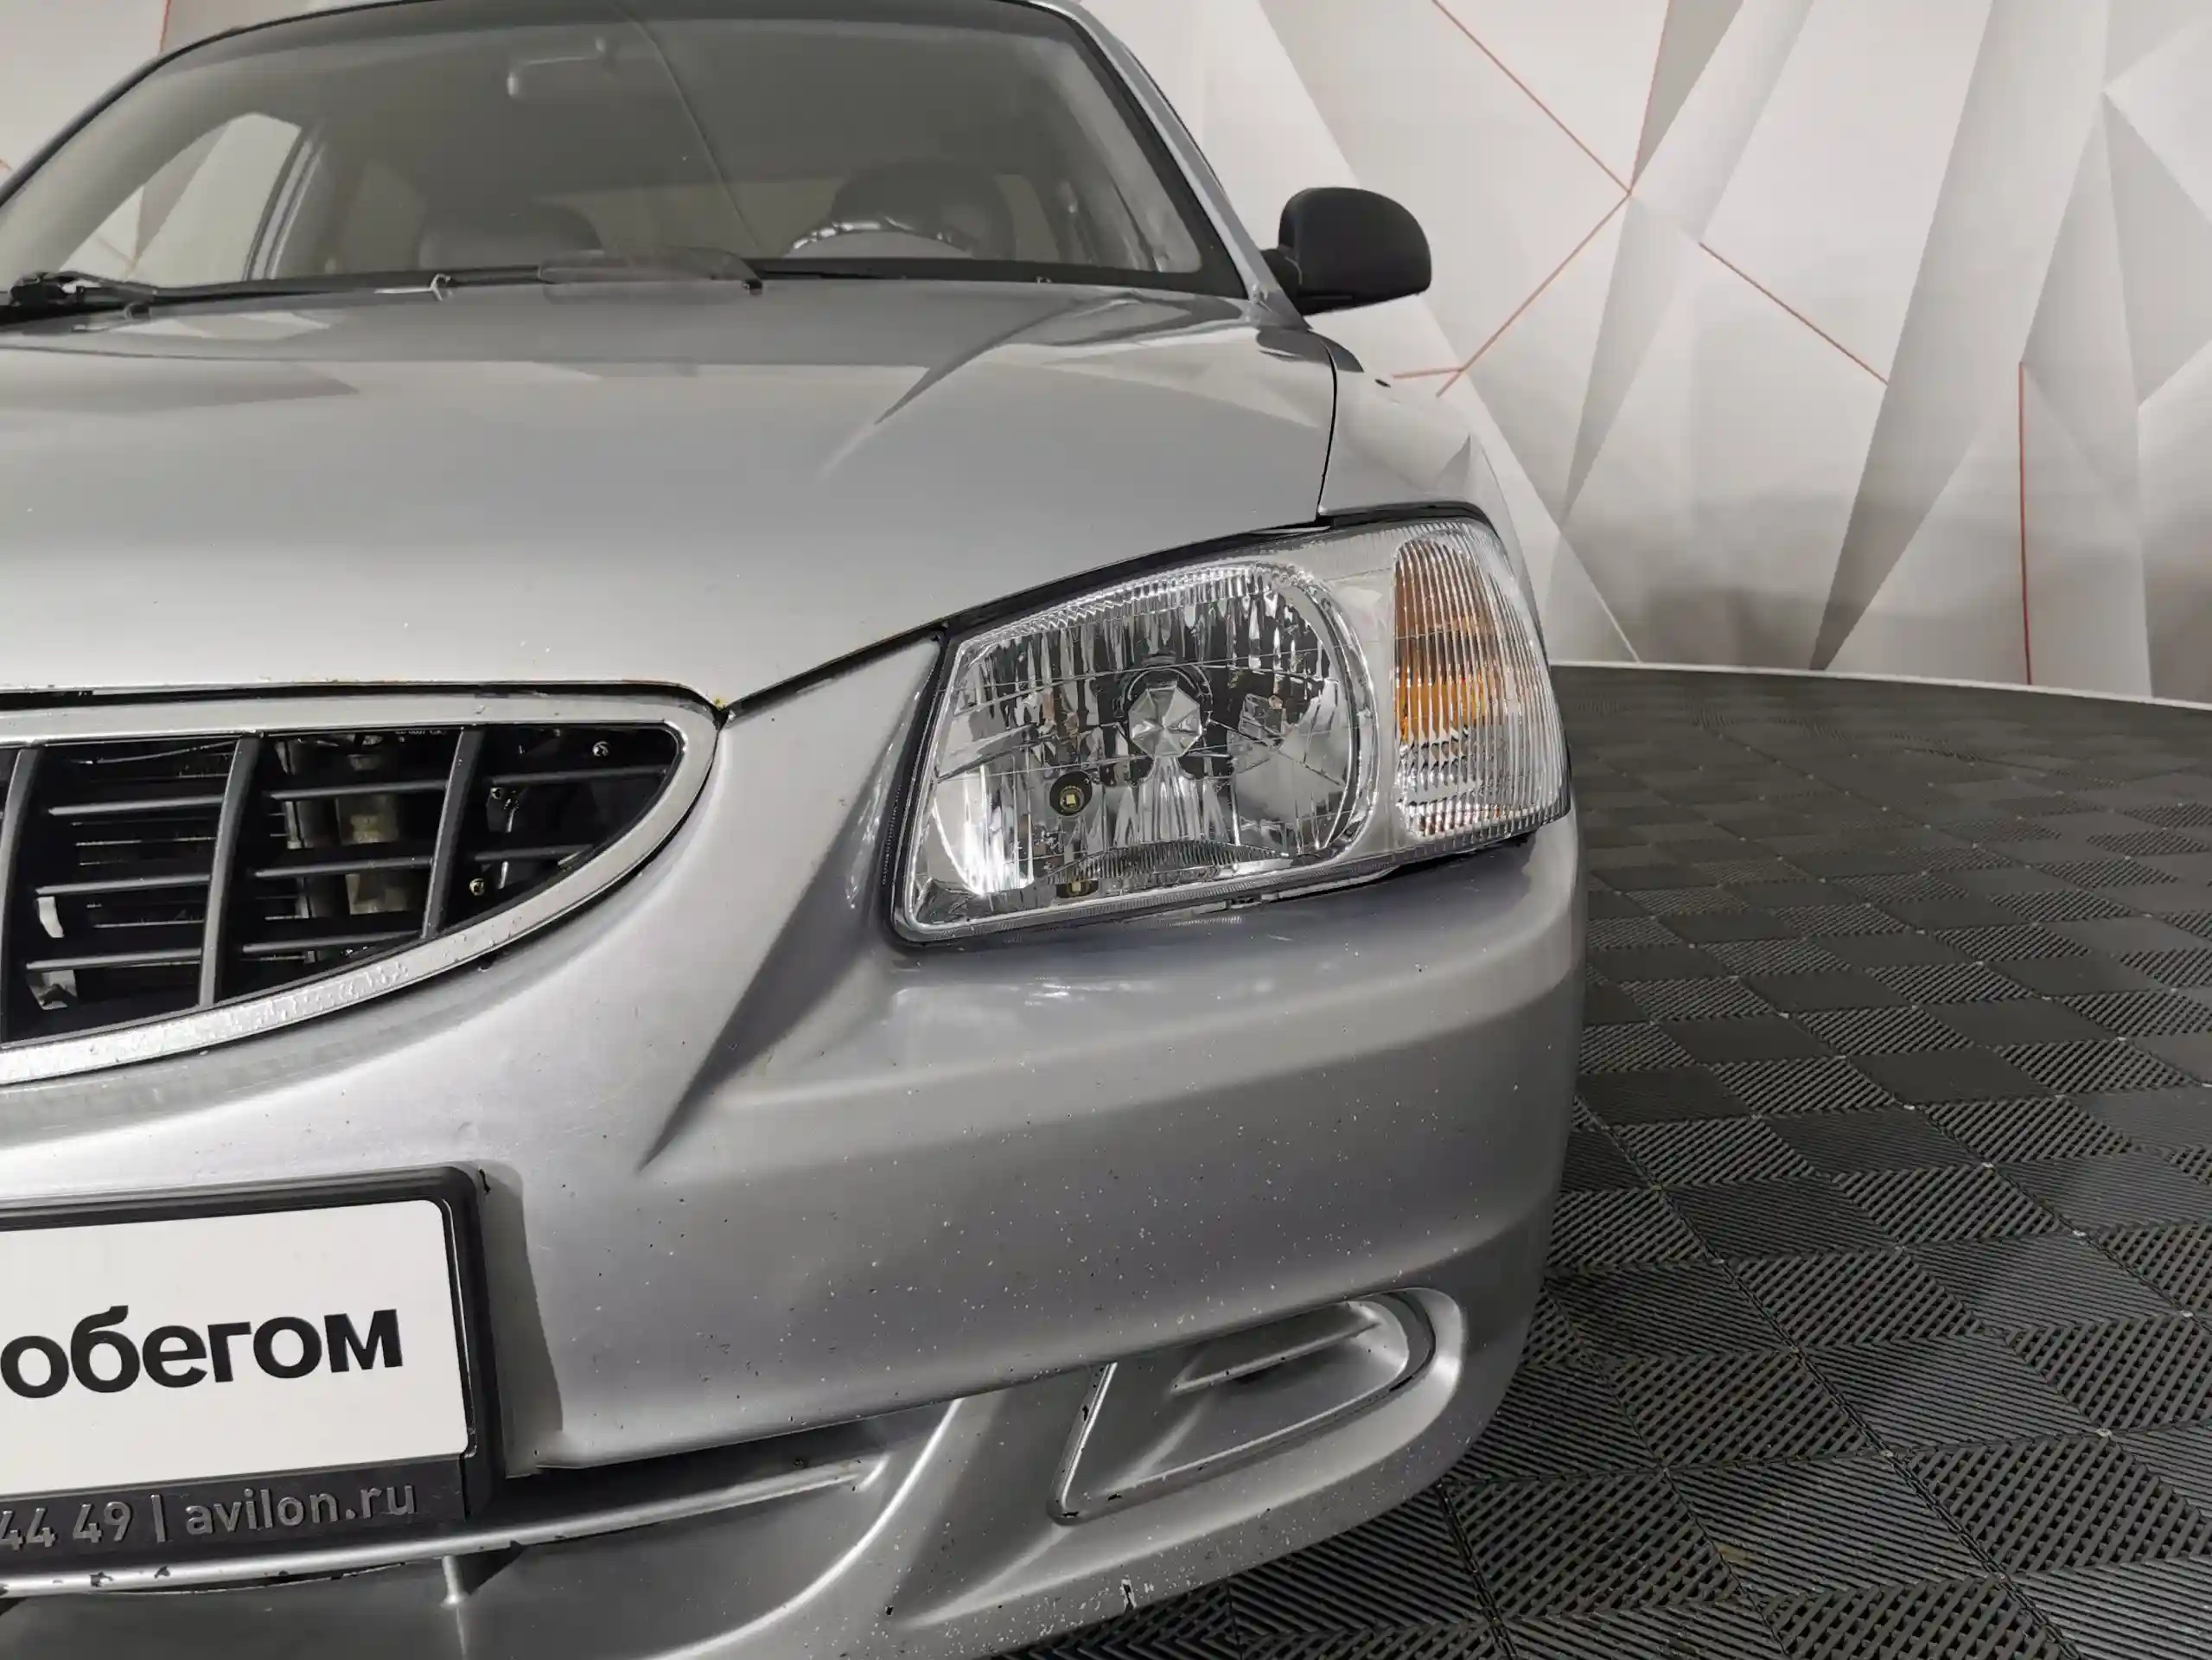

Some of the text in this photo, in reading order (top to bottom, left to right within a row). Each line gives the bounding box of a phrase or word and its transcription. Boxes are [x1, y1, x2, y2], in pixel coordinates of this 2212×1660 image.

[0, 1305, 404, 1399] обегом
[0, 1507, 56, 1551] 44
[73, 1501, 132, 1543] 49
[185, 1484, 416, 1536] avilon.ru
